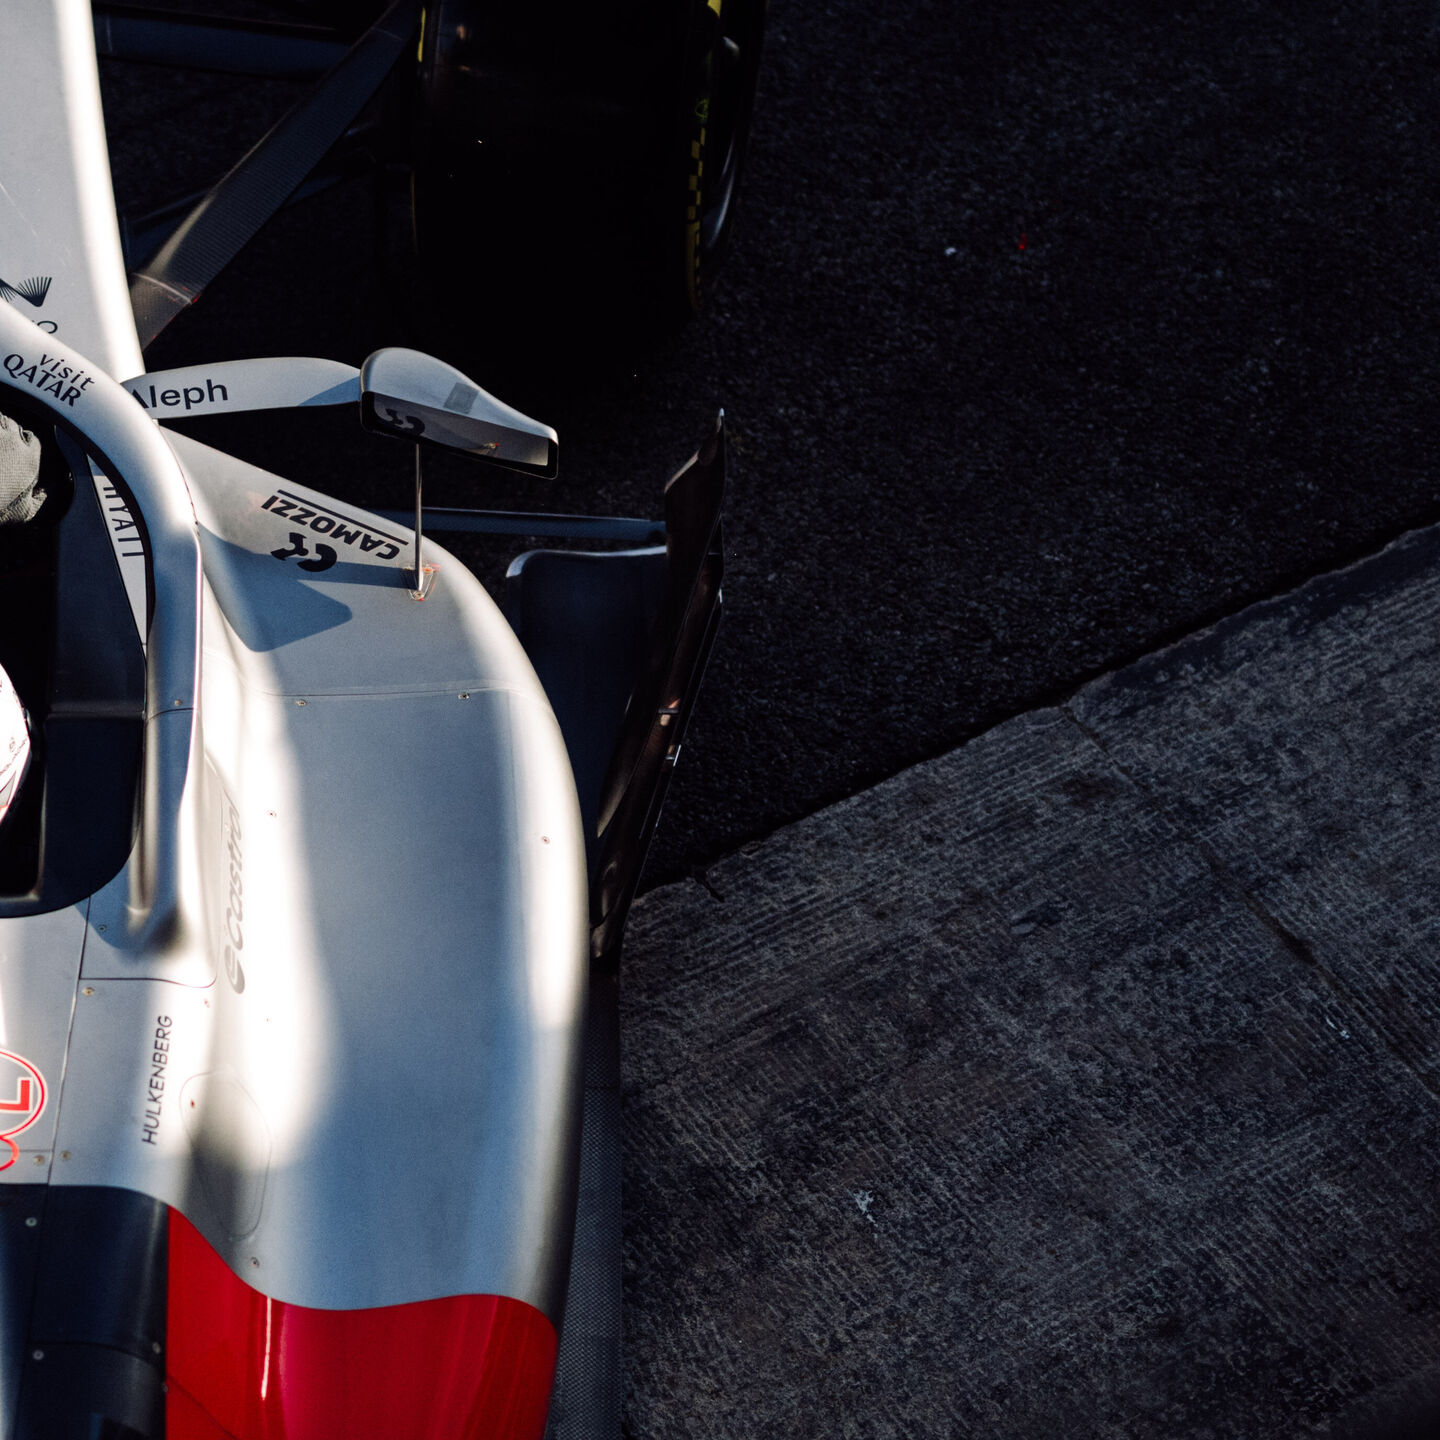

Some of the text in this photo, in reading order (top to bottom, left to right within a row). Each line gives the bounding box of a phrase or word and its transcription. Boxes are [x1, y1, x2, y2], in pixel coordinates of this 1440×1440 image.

[3, 353, 82, 408] QATAR
[39, 353, 95, 391] visit
[132, 378, 228, 410] Aleph
[260, 494, 400, 560] CAMOZZI
[141, 1014, 173, 1146] HULKENBERG
